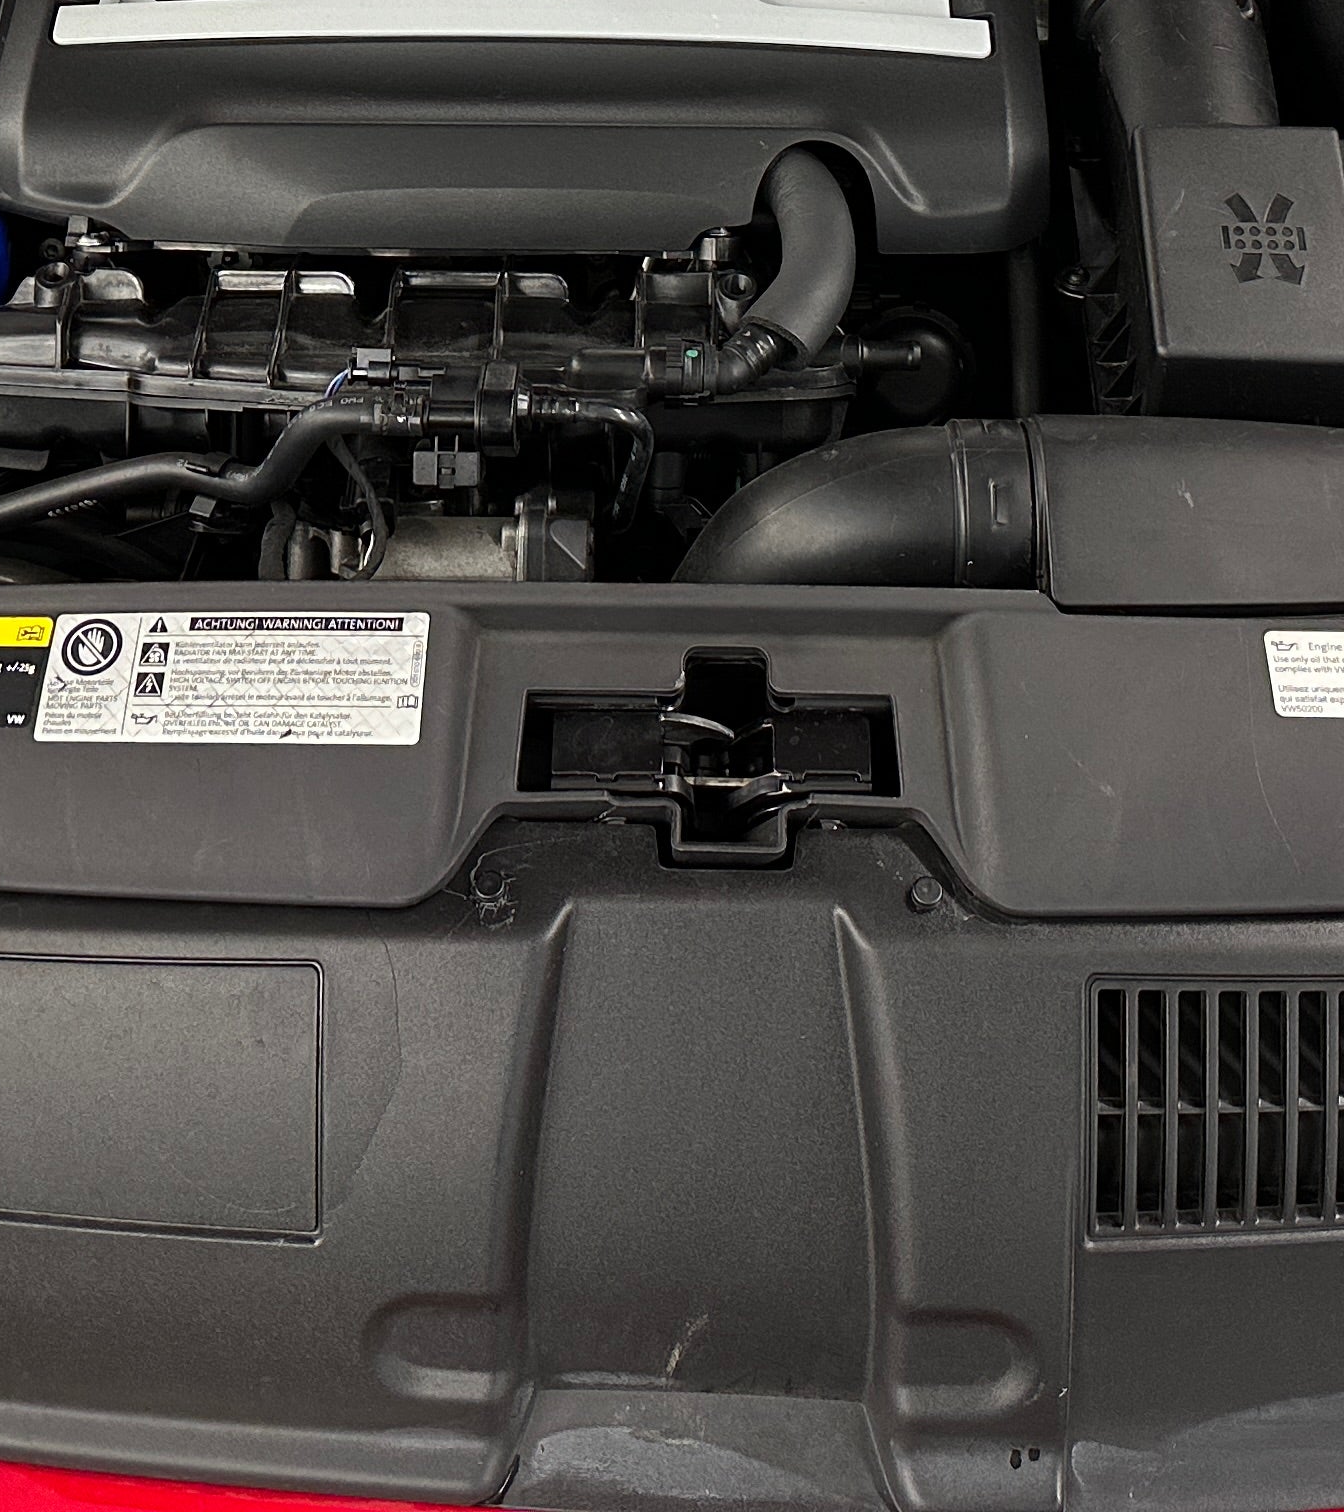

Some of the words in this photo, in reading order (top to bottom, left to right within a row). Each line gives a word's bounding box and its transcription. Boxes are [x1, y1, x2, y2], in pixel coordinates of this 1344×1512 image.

[194, 618, 259, 630] ACHTUNG!
[261, 618, 326, 630] WARNING!
[328, 618, 399, 630] ATTENTION!
[1308, 642, 1343, 653] Engine
[1273, 655, 1289, 663] Use
[1291, 656, 1308, 664] only
[1275, 666, 1312, 674] complies
[6, 714, 26, 725] VW
